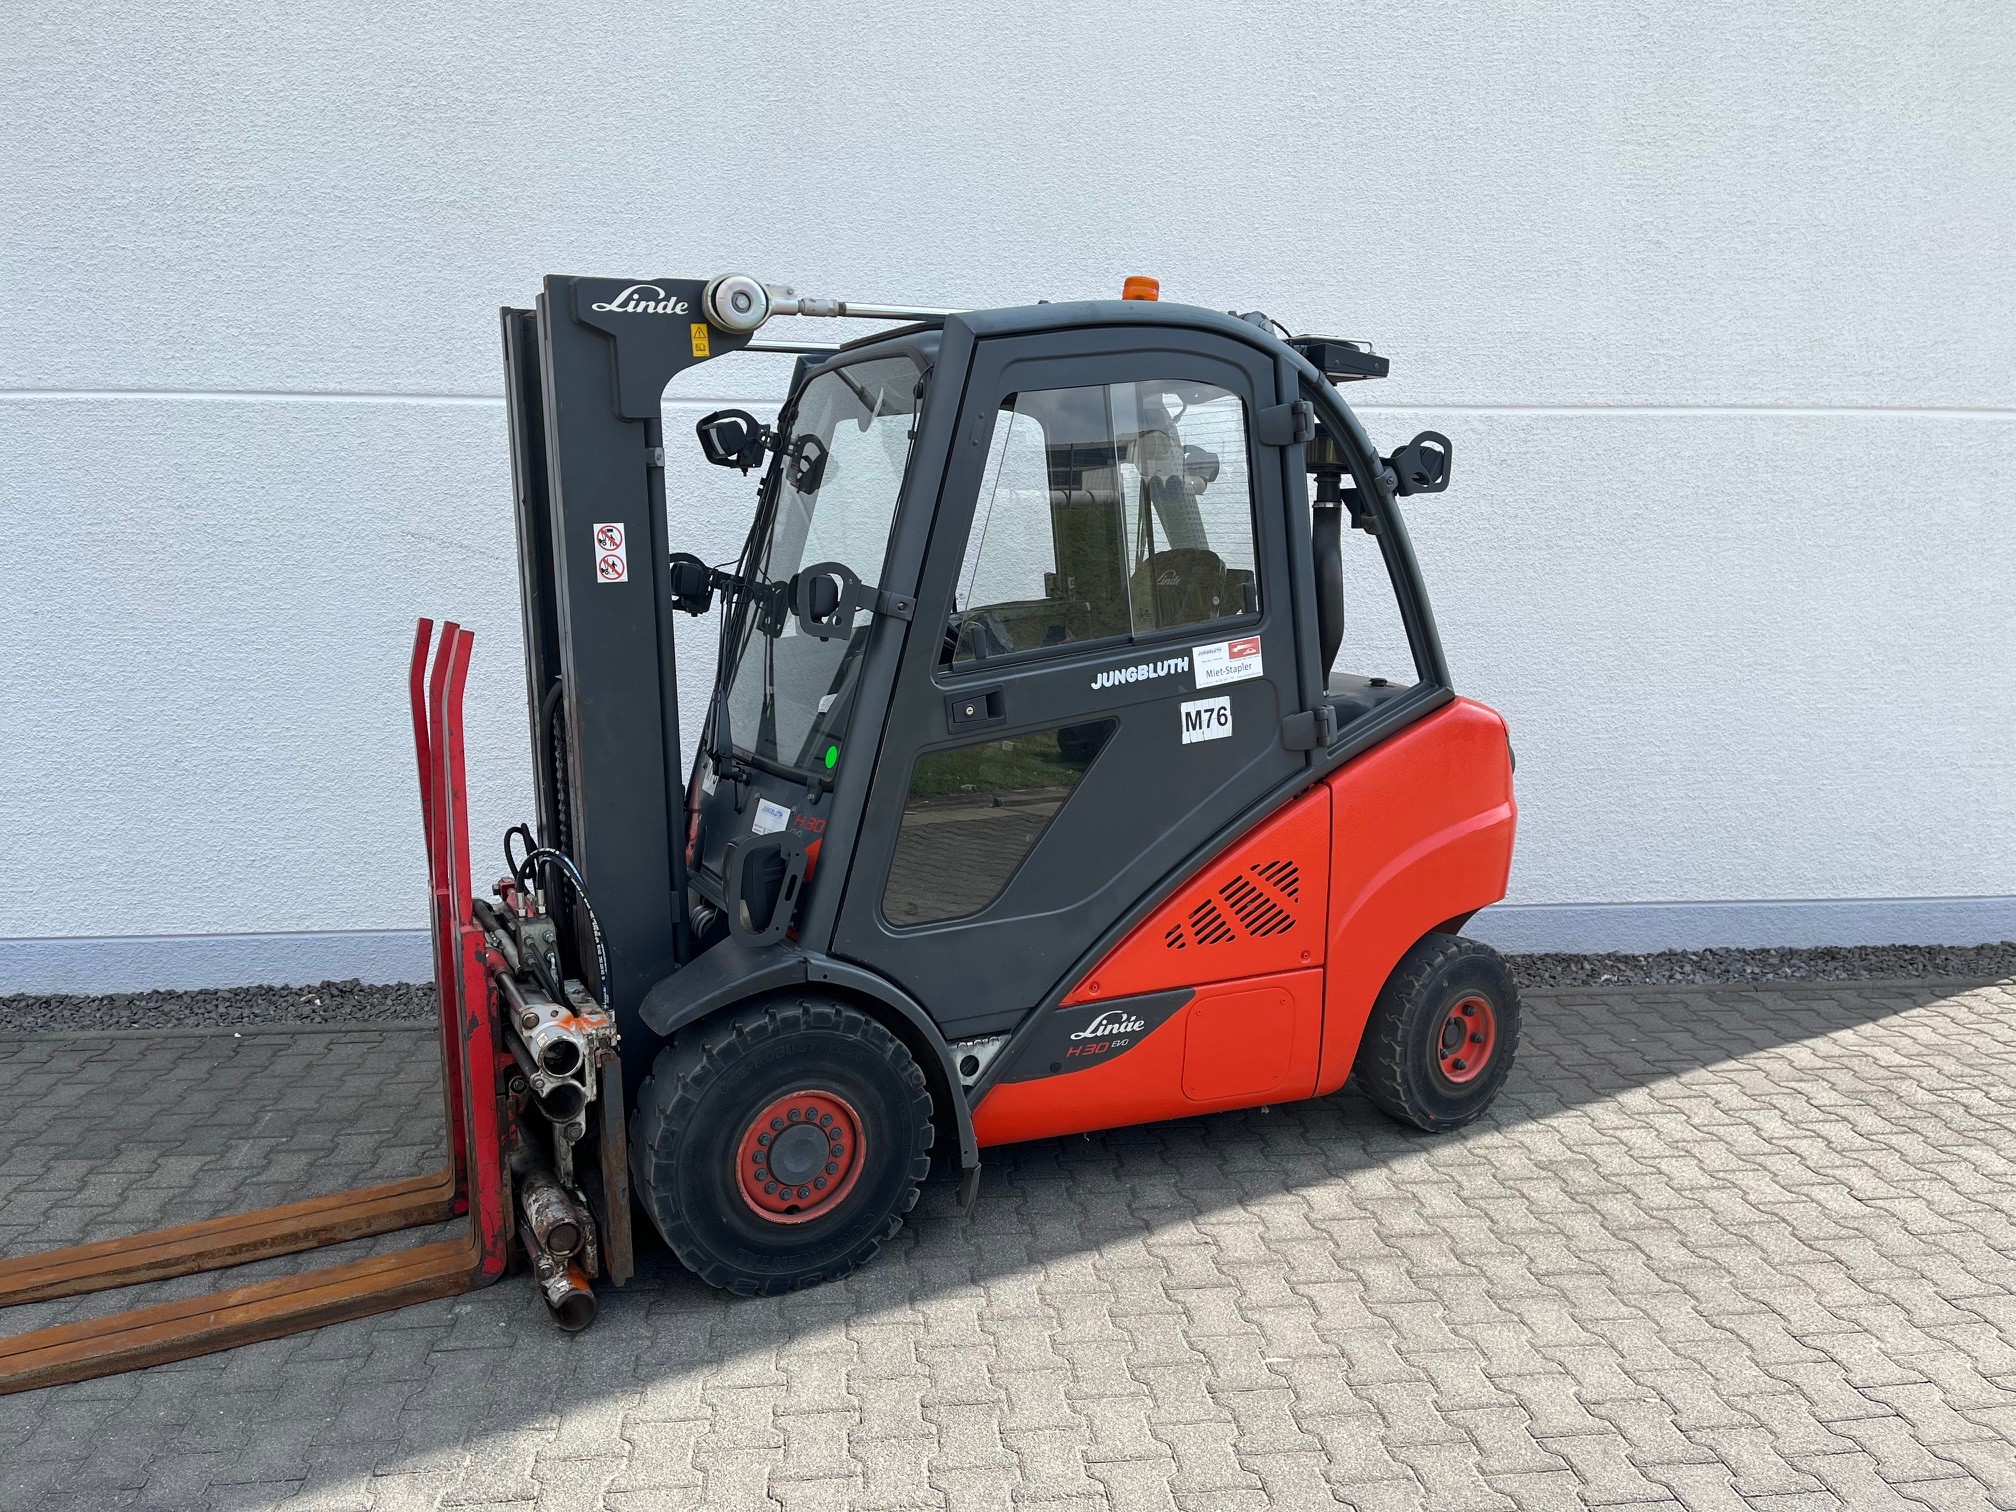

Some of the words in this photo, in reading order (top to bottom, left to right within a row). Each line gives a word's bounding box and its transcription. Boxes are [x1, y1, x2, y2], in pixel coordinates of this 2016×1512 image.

[592, 284, 689, 315] Linde
[1090, 656, 1190, 691] JUNGBLUTH
[1205, 662, 1253, 679] Miet-Stapler
[1184, 705, 1229, 733] M76
[1070, 1010, 1145, 1040] Linde
[1111, 1038, 1130, 1048] EVO
